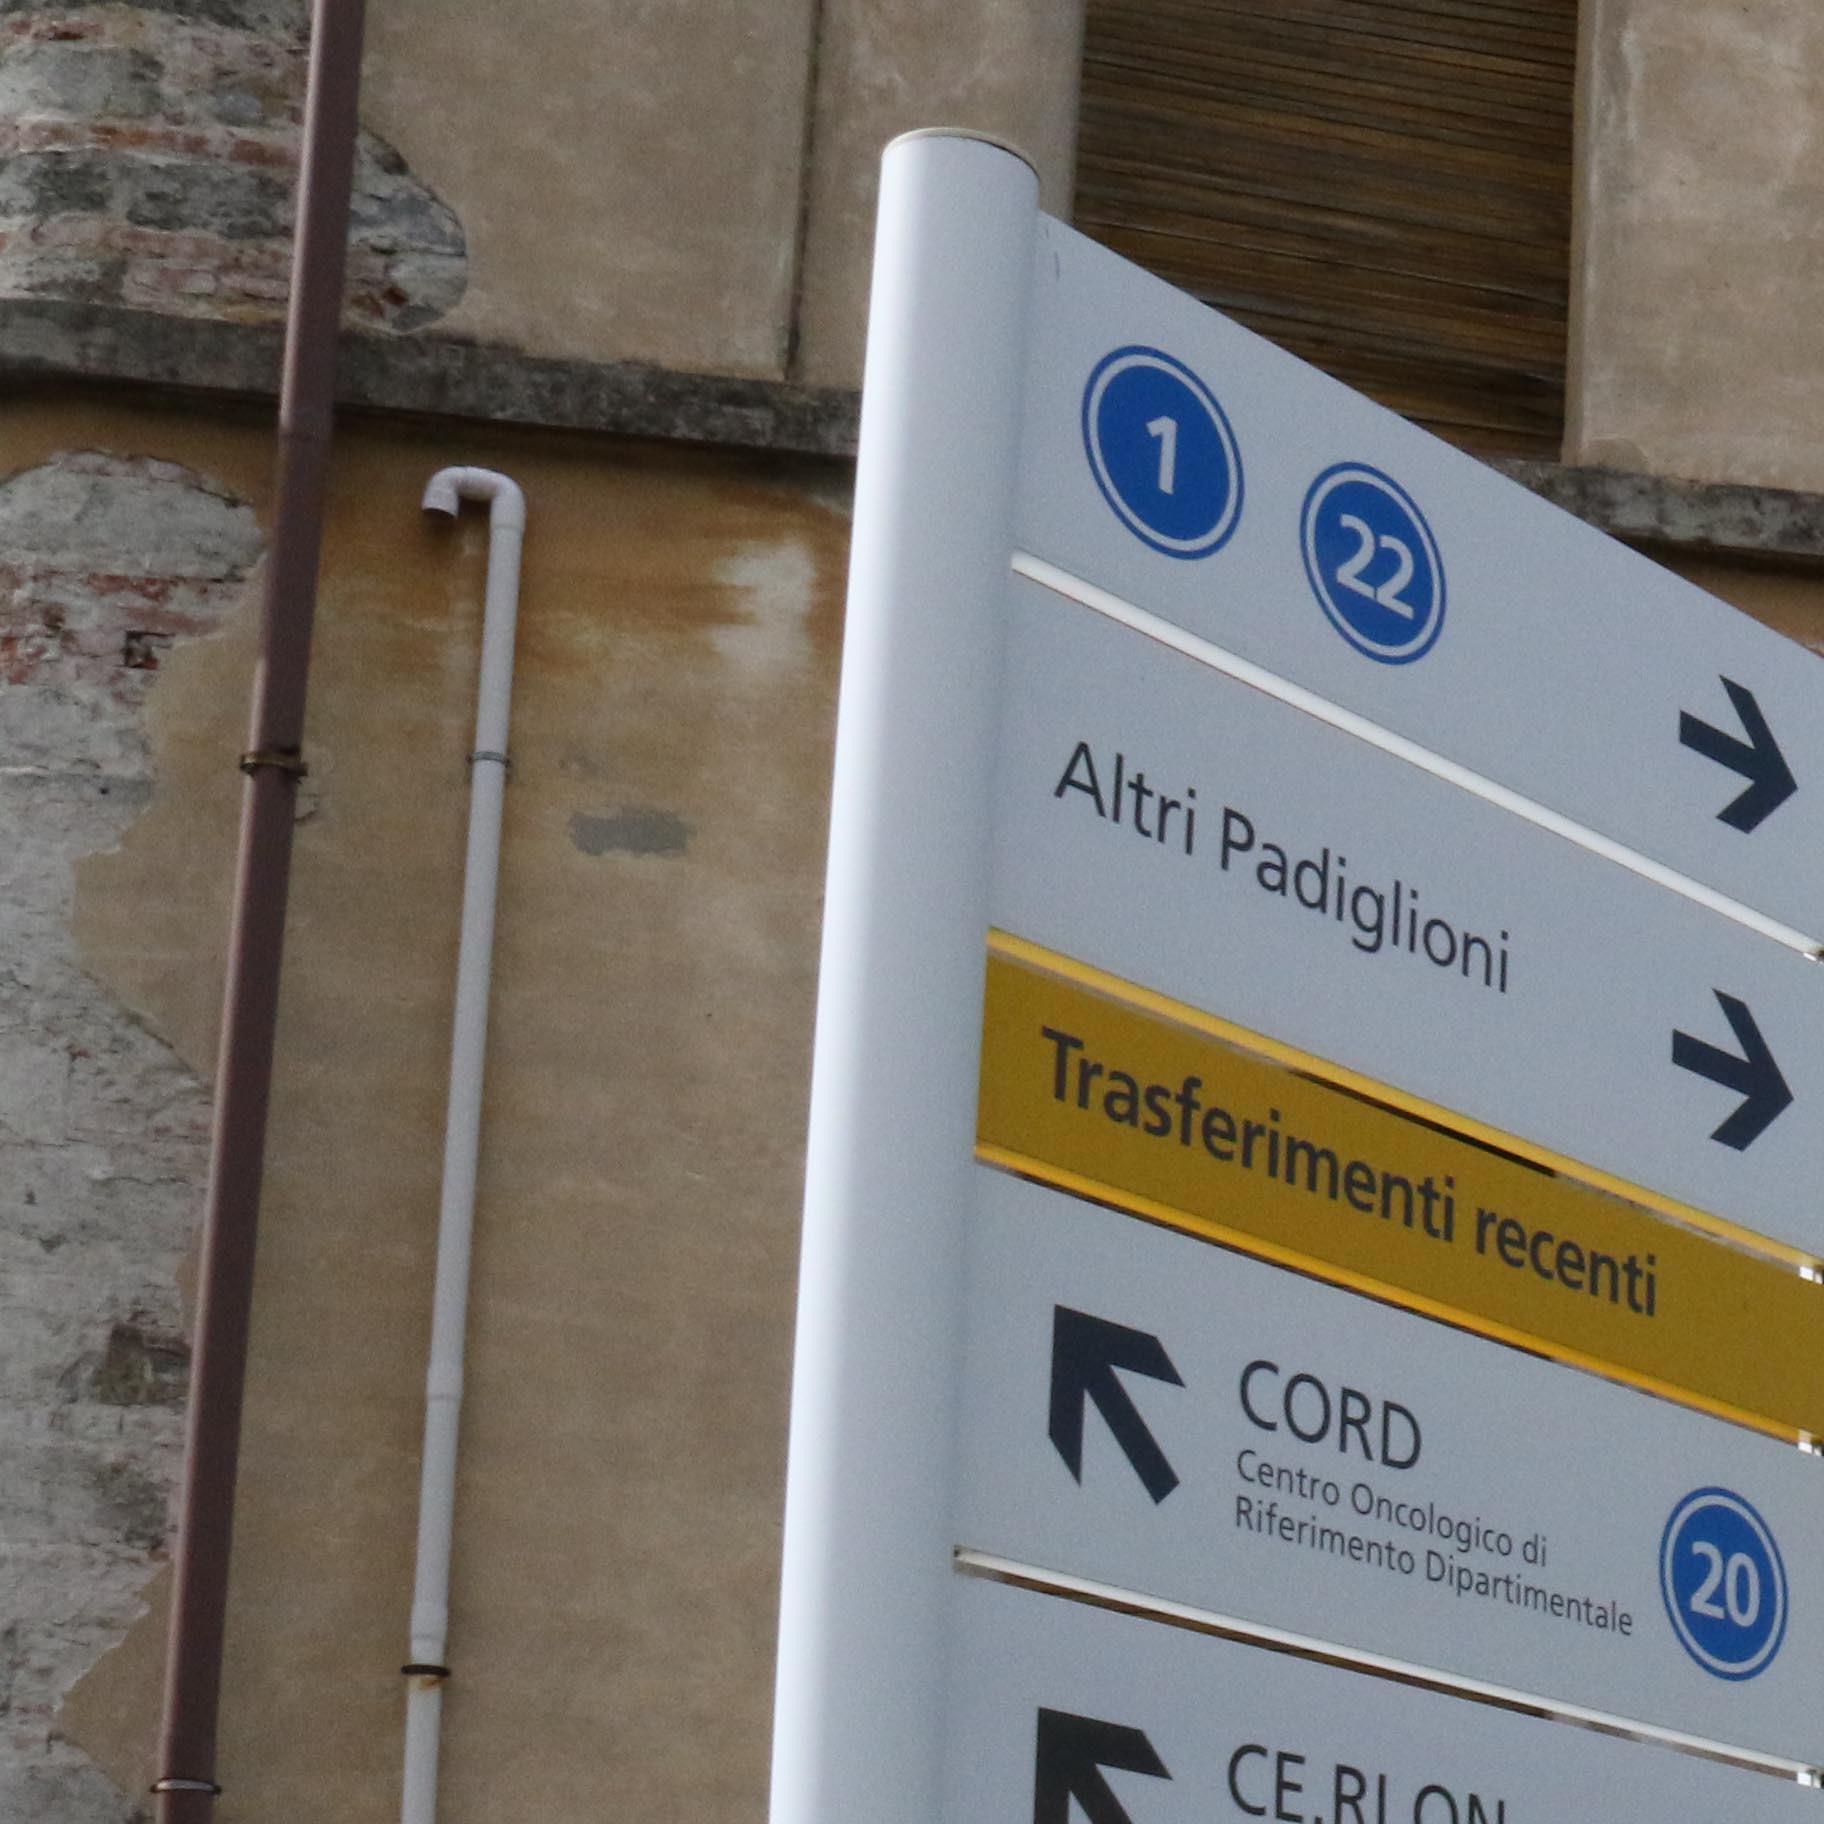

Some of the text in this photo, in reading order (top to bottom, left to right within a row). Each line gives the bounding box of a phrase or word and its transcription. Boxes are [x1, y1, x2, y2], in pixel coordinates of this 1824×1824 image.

[1147, 416, 1177, 494] 1
[1336, 514, 1414, 619] 22
[1054, 741, 1508, 993] Altri Padiglioni
[1042, 1026, 1655, 1316] Trasferimenti recenti
[1240, 1360, 1421, 1470] CORD
[1236, 1494, 1632, 1636] Riferimento Dipartimentale
[1237, 1449, 1546, 1567] Centro Oncologico di
[1690, 1541, 1760, 1627] 20
